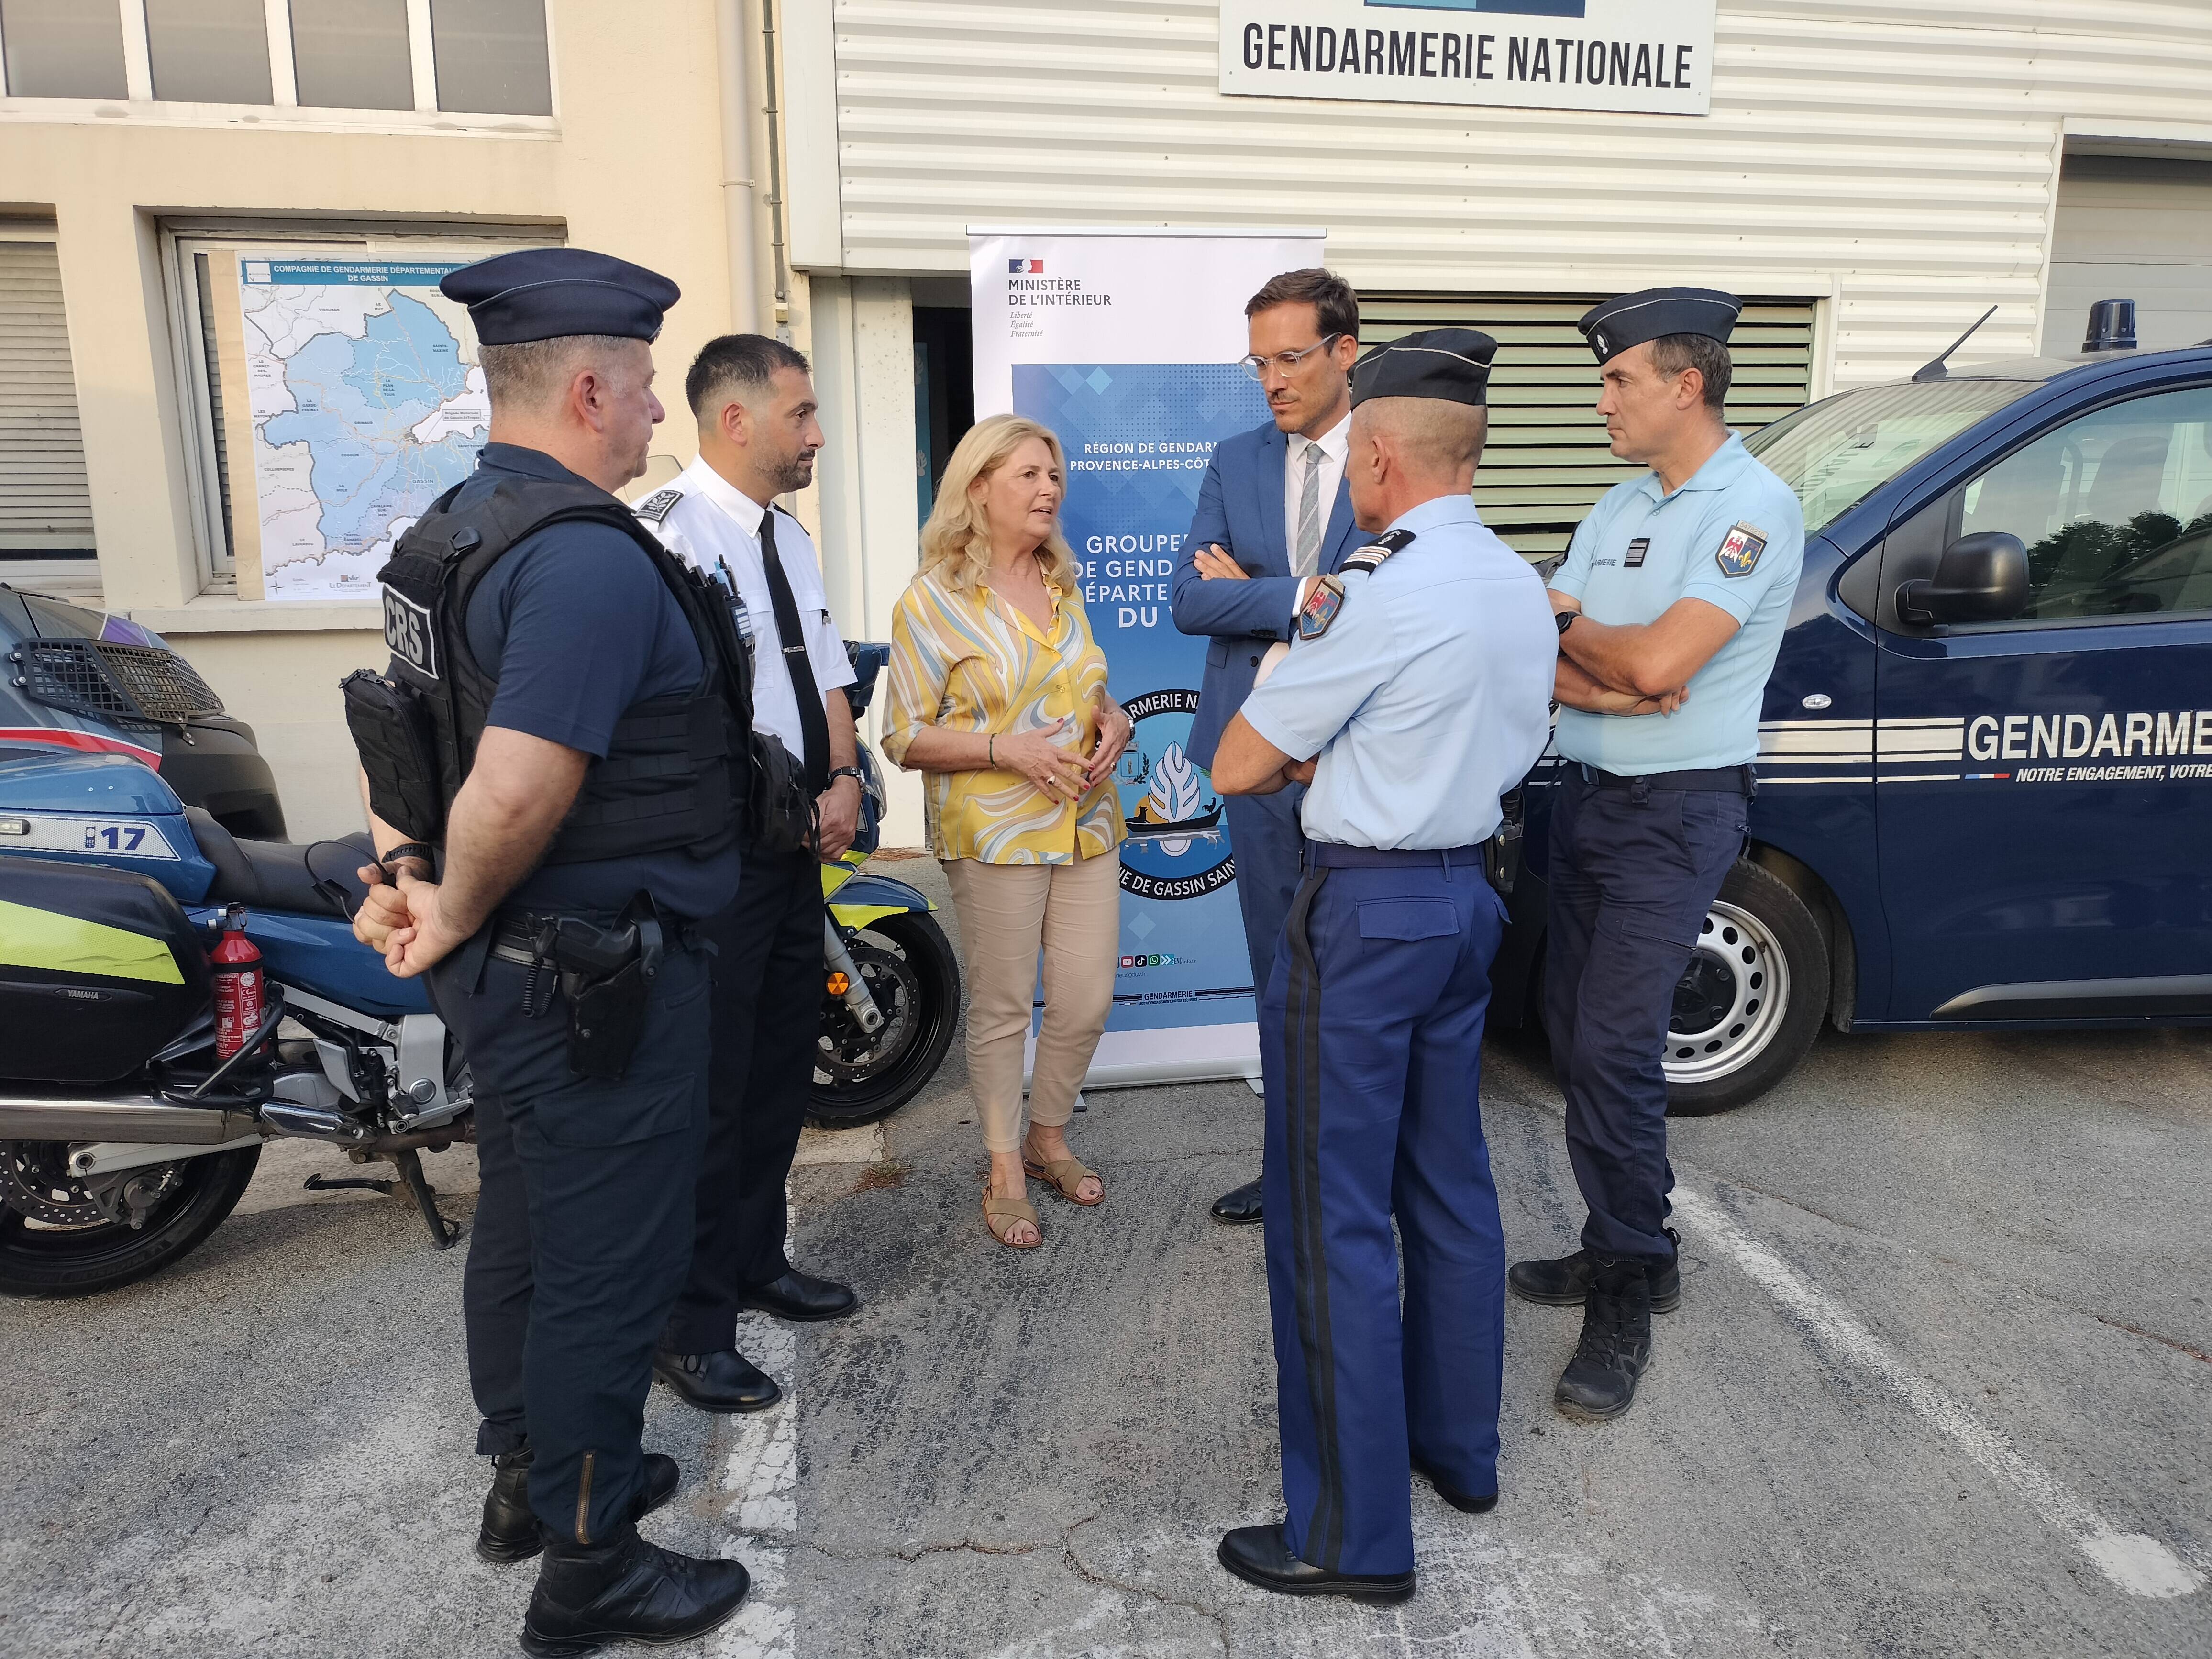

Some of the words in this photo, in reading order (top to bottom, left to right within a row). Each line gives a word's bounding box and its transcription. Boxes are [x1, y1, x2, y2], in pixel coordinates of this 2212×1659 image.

[1244, 23, 1495, 79] GENDARMERIE
[1507, 36, 1693, 89] NATIONALE
[1009, 277, 1081, 291] MINISTÈRE
[1009, 294, 1026, 306] DE
[1031, 291, 1112, 306] L'INTÉRIEUR
[1010, 320, 1033, 329] Égalité
[1084, 442, 1134, 454] RÉGION
[1139, 443, 1155, 453] DE
[1159, 442, 1217, 453] GENDAR
[1086, 534, 1188, 554] GROUPE
[1106, 559, 1173, 578] GEND
[1118, 607, 1158, 628] DU
[385, 595, 423, 664] CRS
[2016, 767, 2065, 782] NOTRE
[2066, 765, 2166, 782] ENGAGEMENT,
[2169, 764, 2212, 780] VOTRE
[101, 827, 145, 851] 17
[1132, 875, 1151, 893] DE
[1154, 877, 1206, 896] GASSIN
[68, 989, 99, 999] YAMAHA
[1144, 990, 1193, 1000] GENDARMERIE
